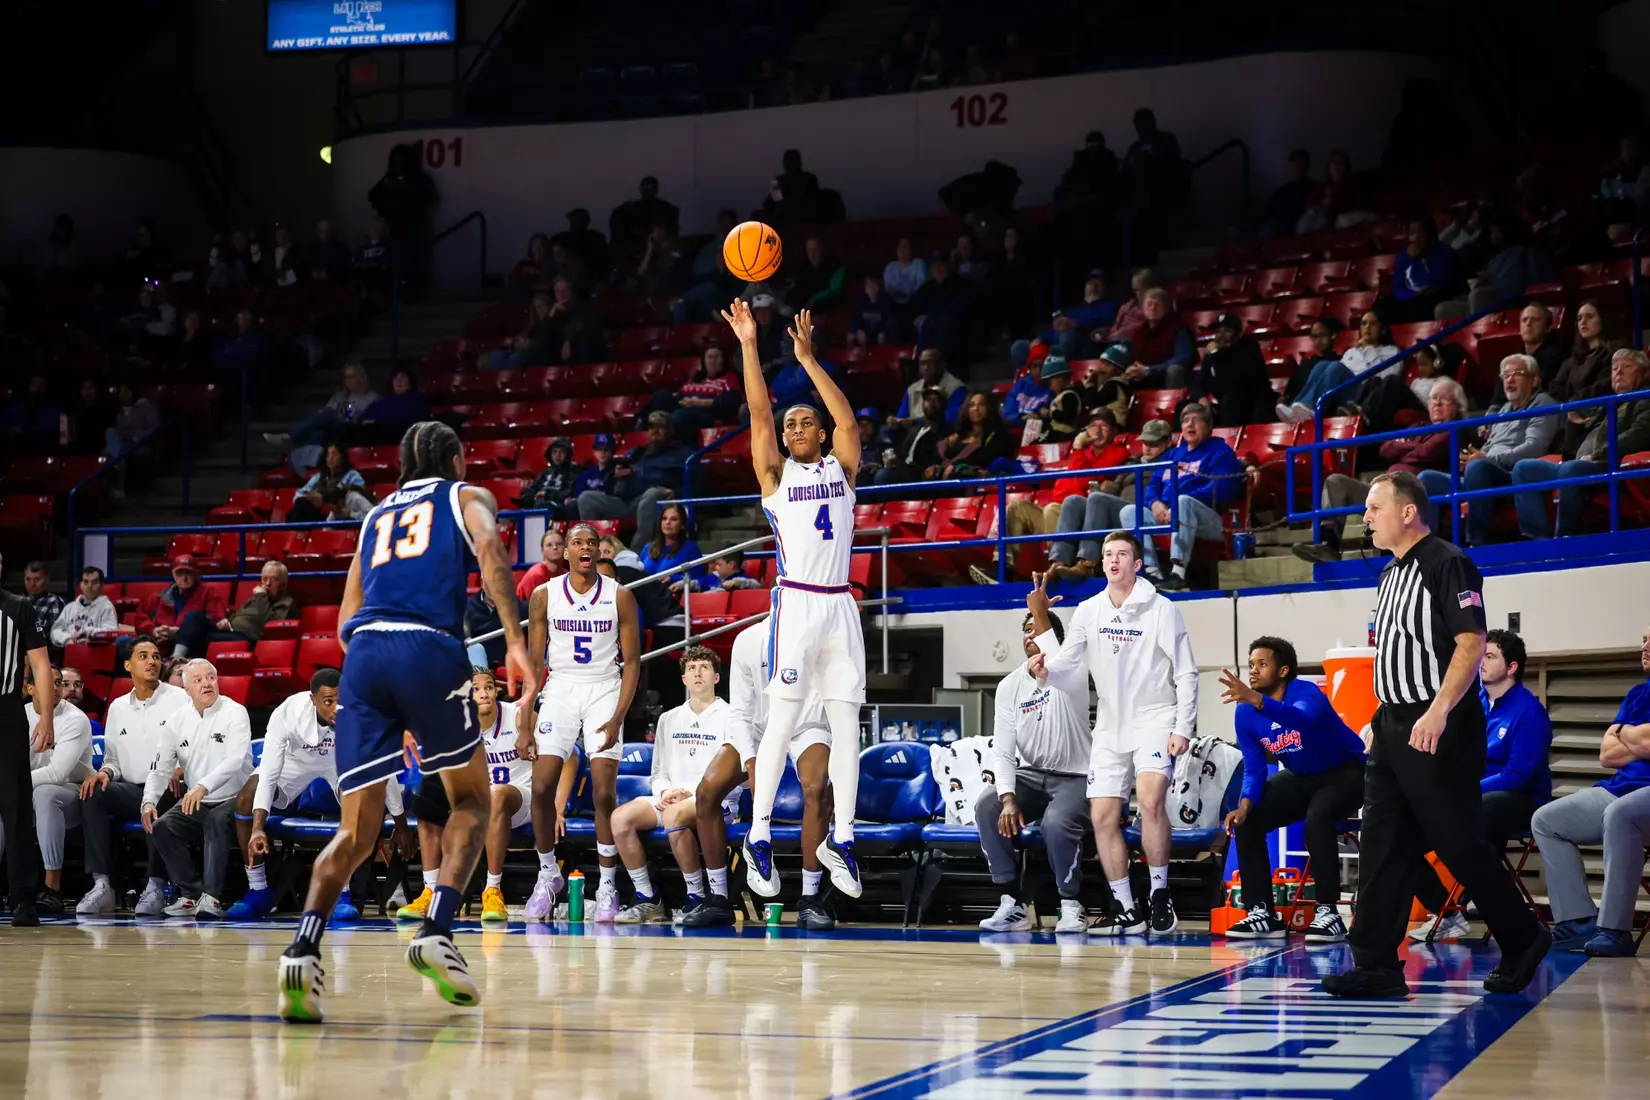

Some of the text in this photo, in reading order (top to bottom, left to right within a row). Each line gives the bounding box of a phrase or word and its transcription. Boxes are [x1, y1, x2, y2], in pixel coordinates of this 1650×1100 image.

[273, 31, 450, 48] ANY GIFT. ANY SIZE. EVERY YEAR.
[950, 91, 1008, 128] 102
[788, 480, 845, 502] LOUISIANA TECH
[813, 503, 834, 540] 4
[371, 500, 434, 569] 13
[553, 618, 612, 633] LOUISIANA TECH
[573, 635, 593, 664] 5
[1292, 909, 1305, 926] G
